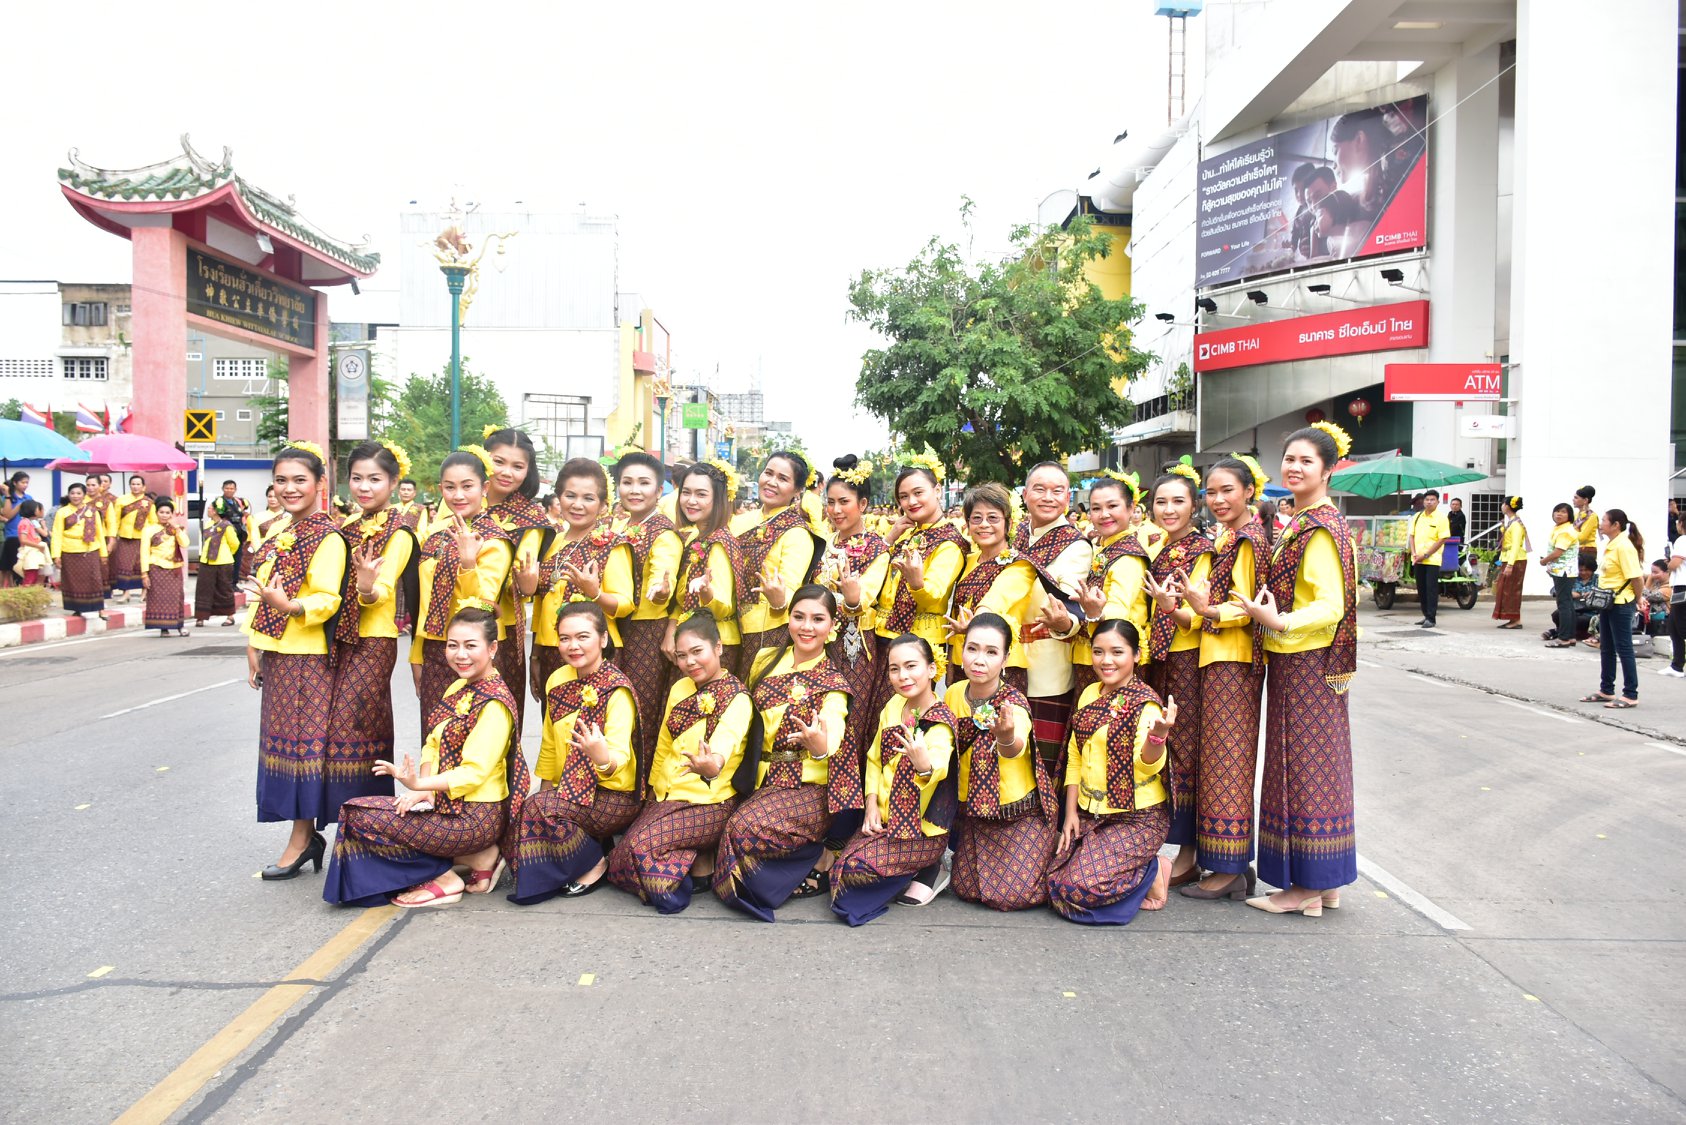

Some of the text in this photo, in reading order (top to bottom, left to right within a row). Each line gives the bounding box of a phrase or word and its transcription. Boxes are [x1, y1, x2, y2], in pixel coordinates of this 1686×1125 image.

[1384, 232, 1401, 242] CIMB
[1403, 230, 1418, 238] THAI
[1299, 318, 1413, 344] ธนาคาร ซีไอเอ็มบี ไทย
[1211, 338, 1260, 356] CIMB THAI
[1464, 375, 1500, 390] ATM
